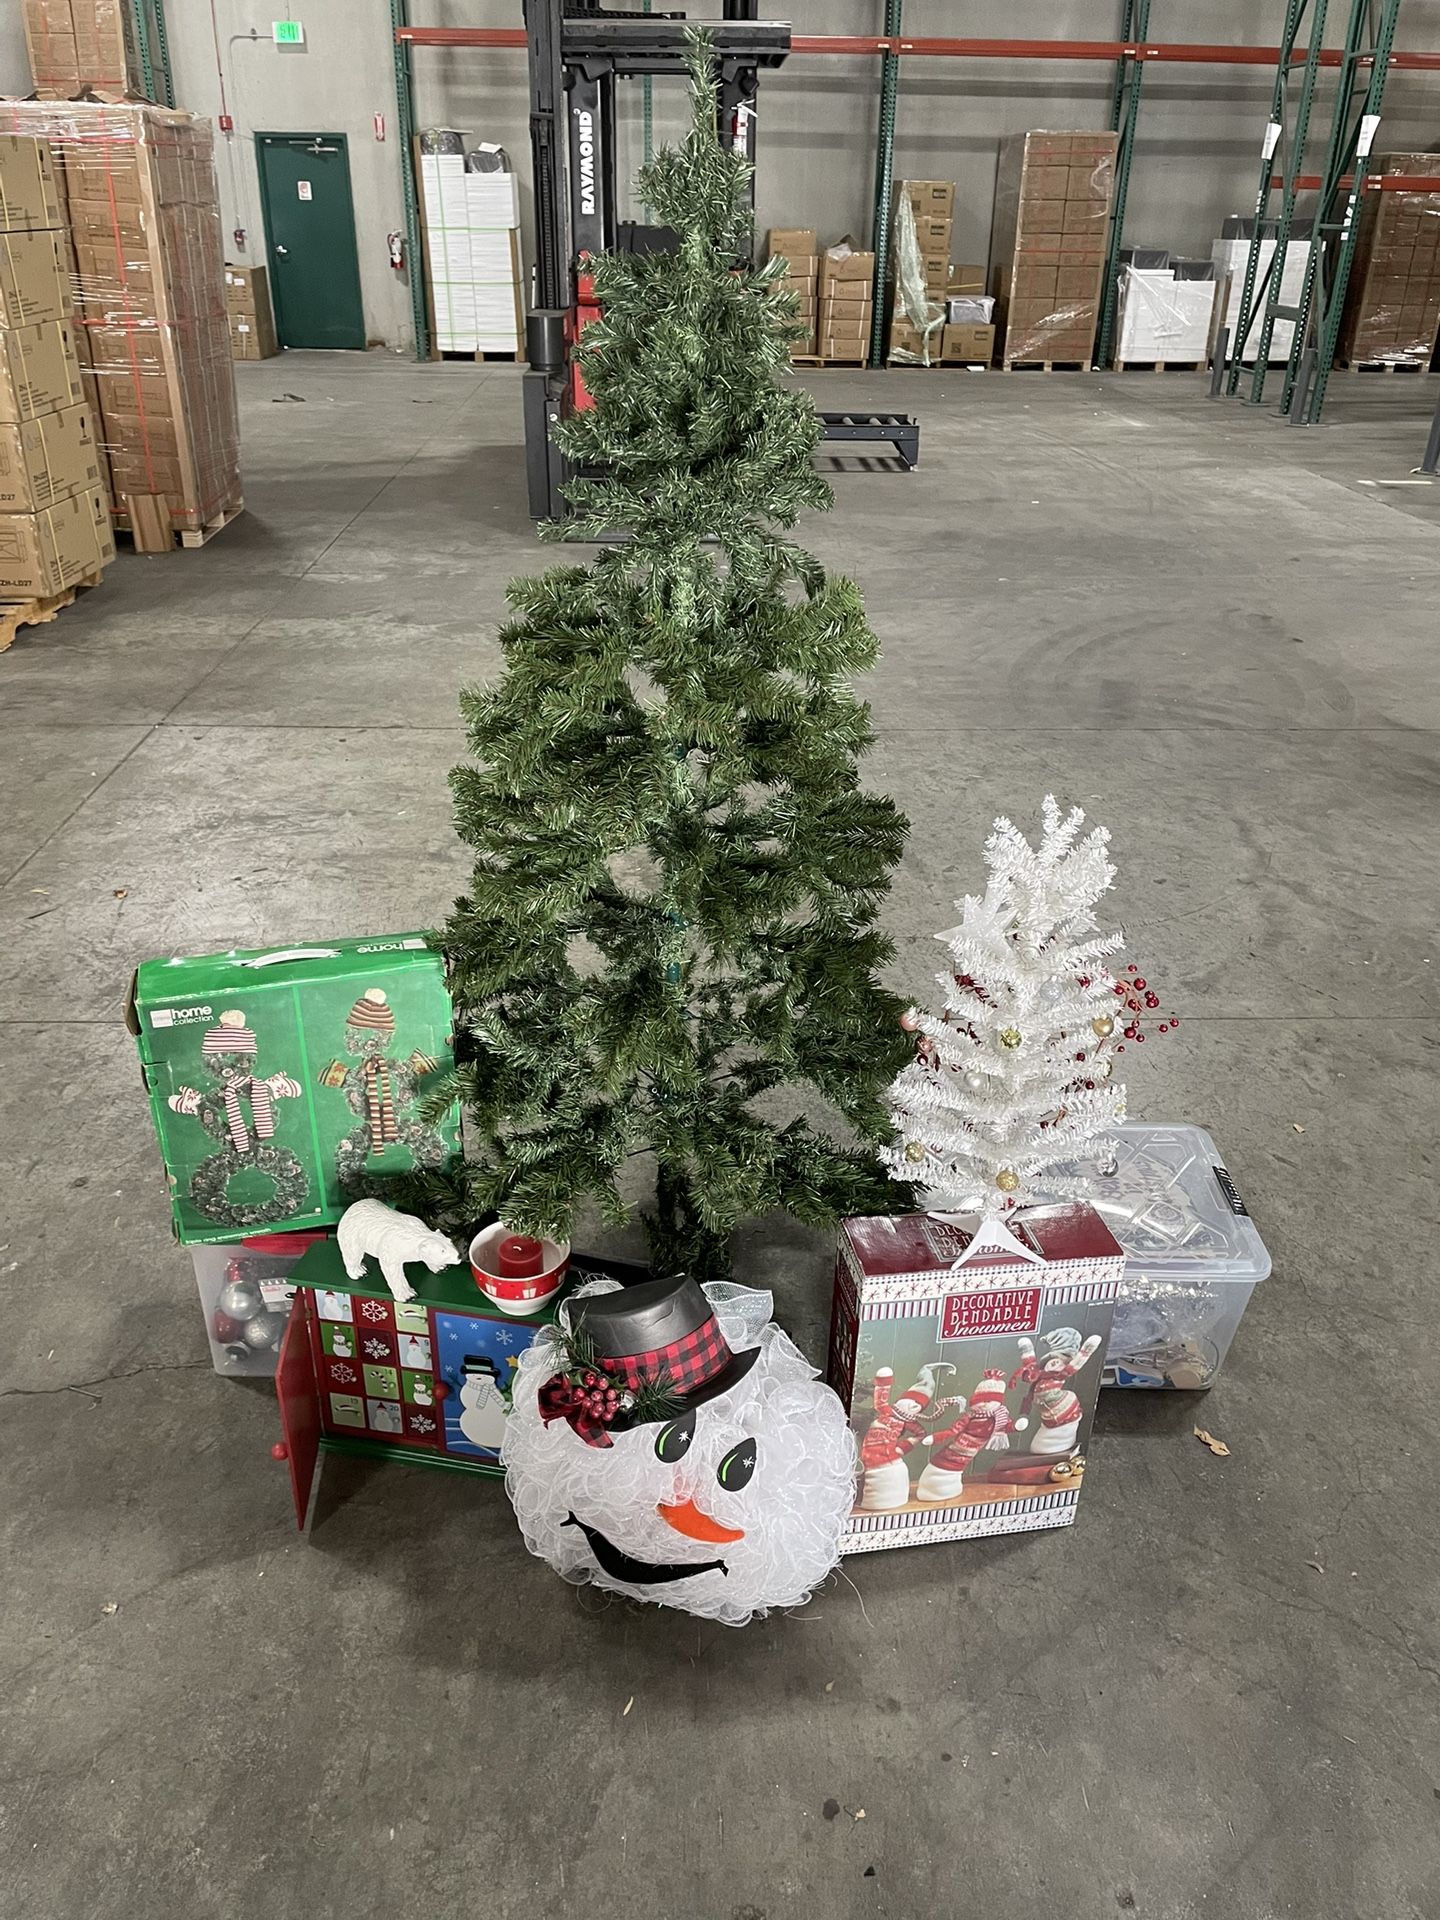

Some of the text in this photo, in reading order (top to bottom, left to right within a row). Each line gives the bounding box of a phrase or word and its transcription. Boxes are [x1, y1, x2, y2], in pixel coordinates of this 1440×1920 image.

[579, 111, 595, 215] RAYMOND
[171, 1005, 213, 1020] home
[173, 1015, 214, 1026] collection
[952, 1290, 1034, 1311] DECORATIVE
[950, 1305, 1032, 1326] BENDABLE
[944, 1320, 1034, 1337] Snowmen
